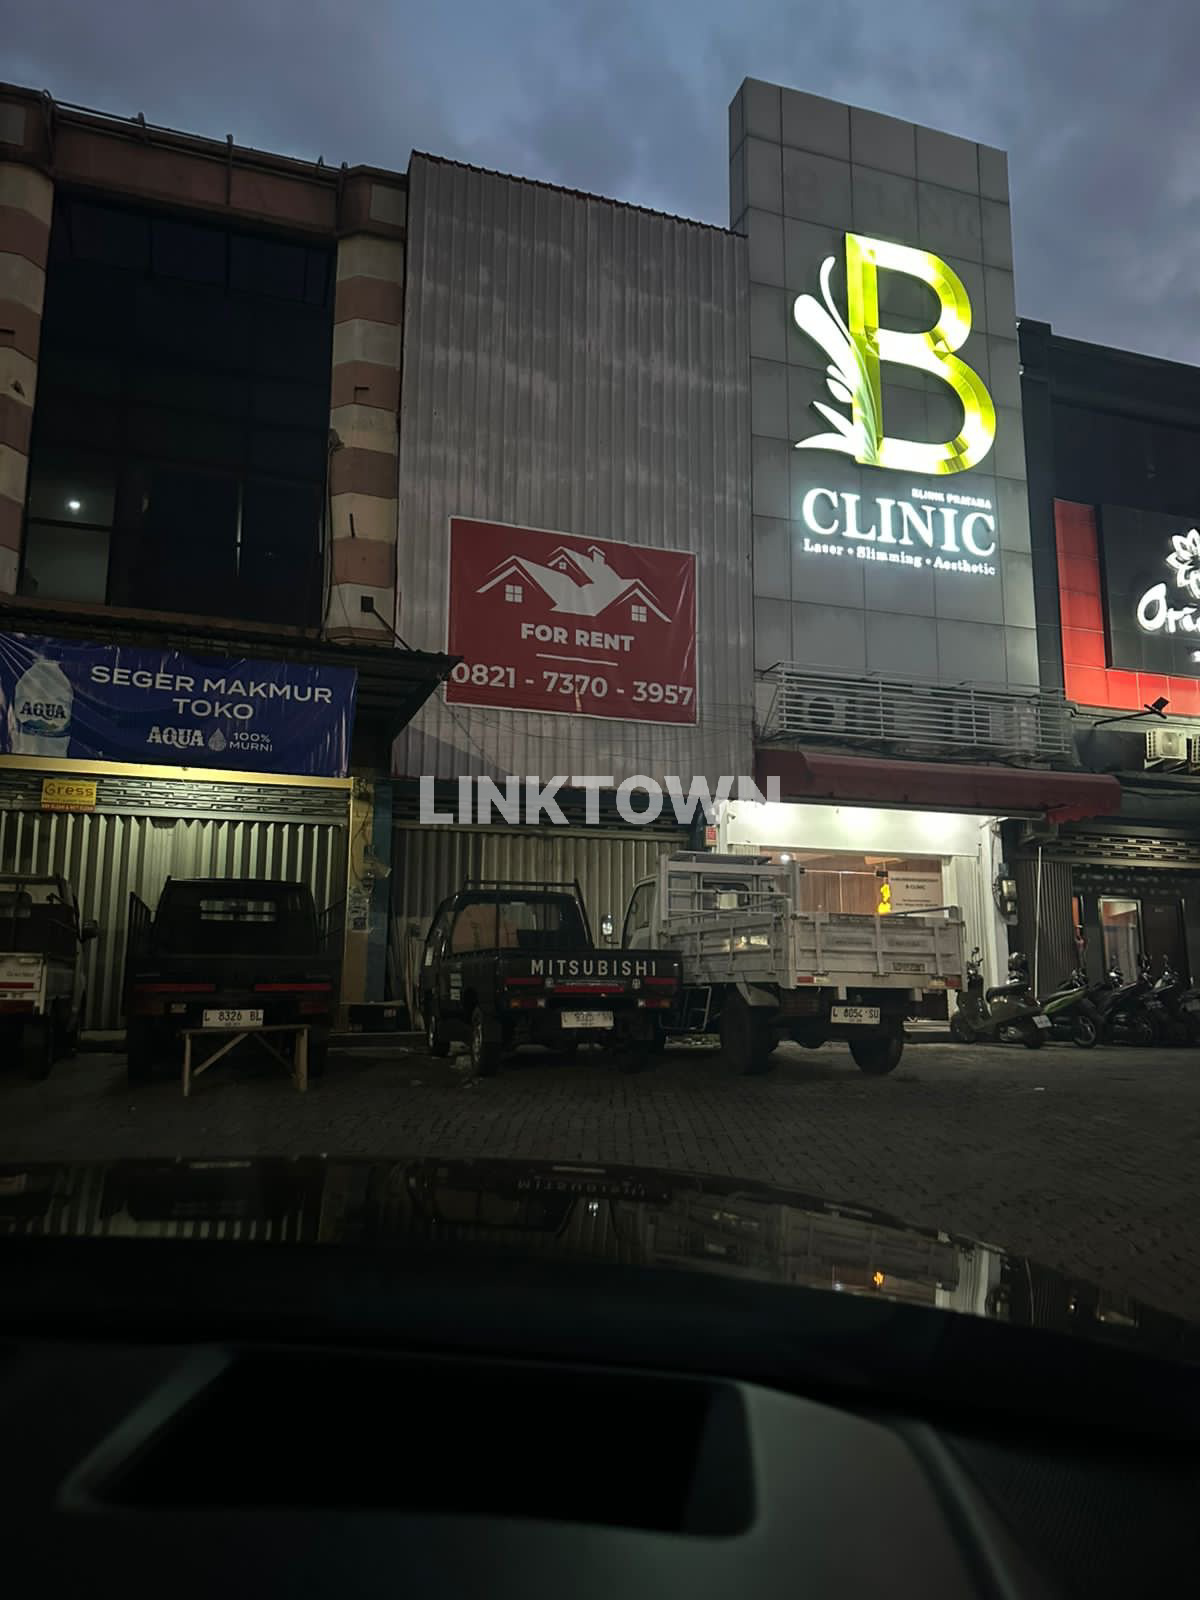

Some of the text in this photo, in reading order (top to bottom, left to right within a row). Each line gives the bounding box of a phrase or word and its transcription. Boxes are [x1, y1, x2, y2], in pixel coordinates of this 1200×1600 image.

[846, 232, 996, 475] B
[802, 487, 996, 557] CLINIC
[856, 545, 922, 568] Slimming
[933, 555, 996, 576] Aesthetic
[520, 622, 635, 652] FOR RENT
[90, 665, 333, 704] SEGER MAKMUR
[451, 662, 516, 689] 0821
[542, 671, 608, 698] 7370
[632, 680, 694, 706] 3957
[20, 702, 66, 720] AQUA
[172, 698, 256, 721] TOKO
[146, 725, 271, 749] AQUA 100%
[230, 741, 273, 752] MURNI
[45, 783, 95, 796] Gress
[531, 959, 657, 977] MITSUBISHI
[218, 1011, 243, 1021] 8326
